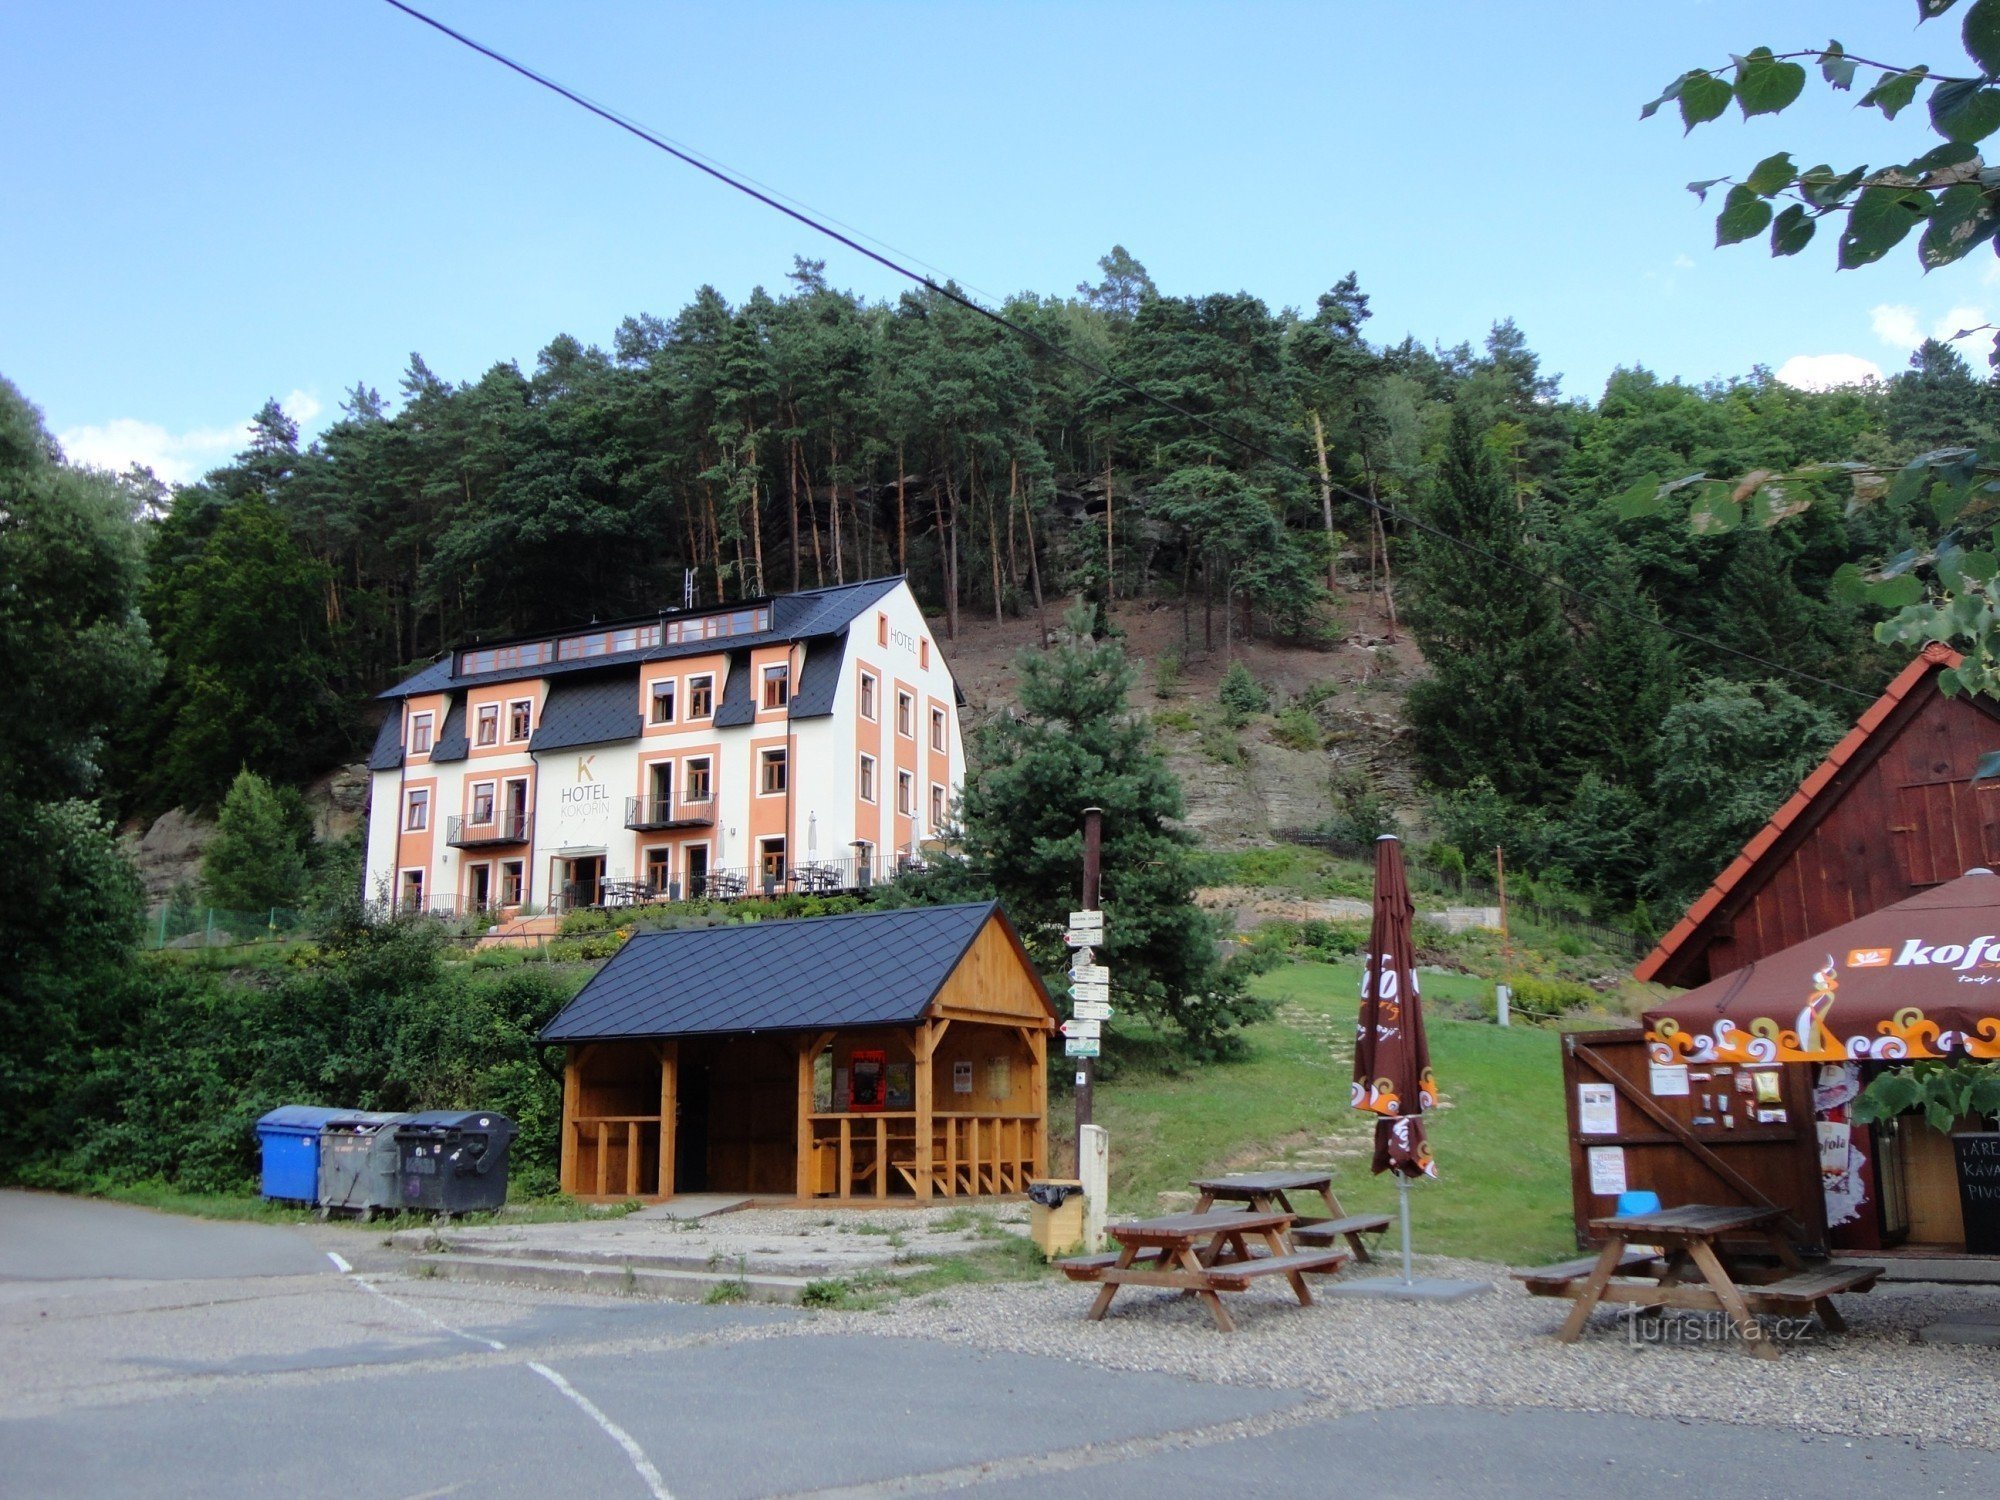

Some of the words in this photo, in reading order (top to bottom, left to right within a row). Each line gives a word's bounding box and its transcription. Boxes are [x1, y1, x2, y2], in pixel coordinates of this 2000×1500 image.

[890, 626, 917, 655] HOTEL
[577, 754, 596, 783] K
[561, 783, 610, 803] HOTEL
